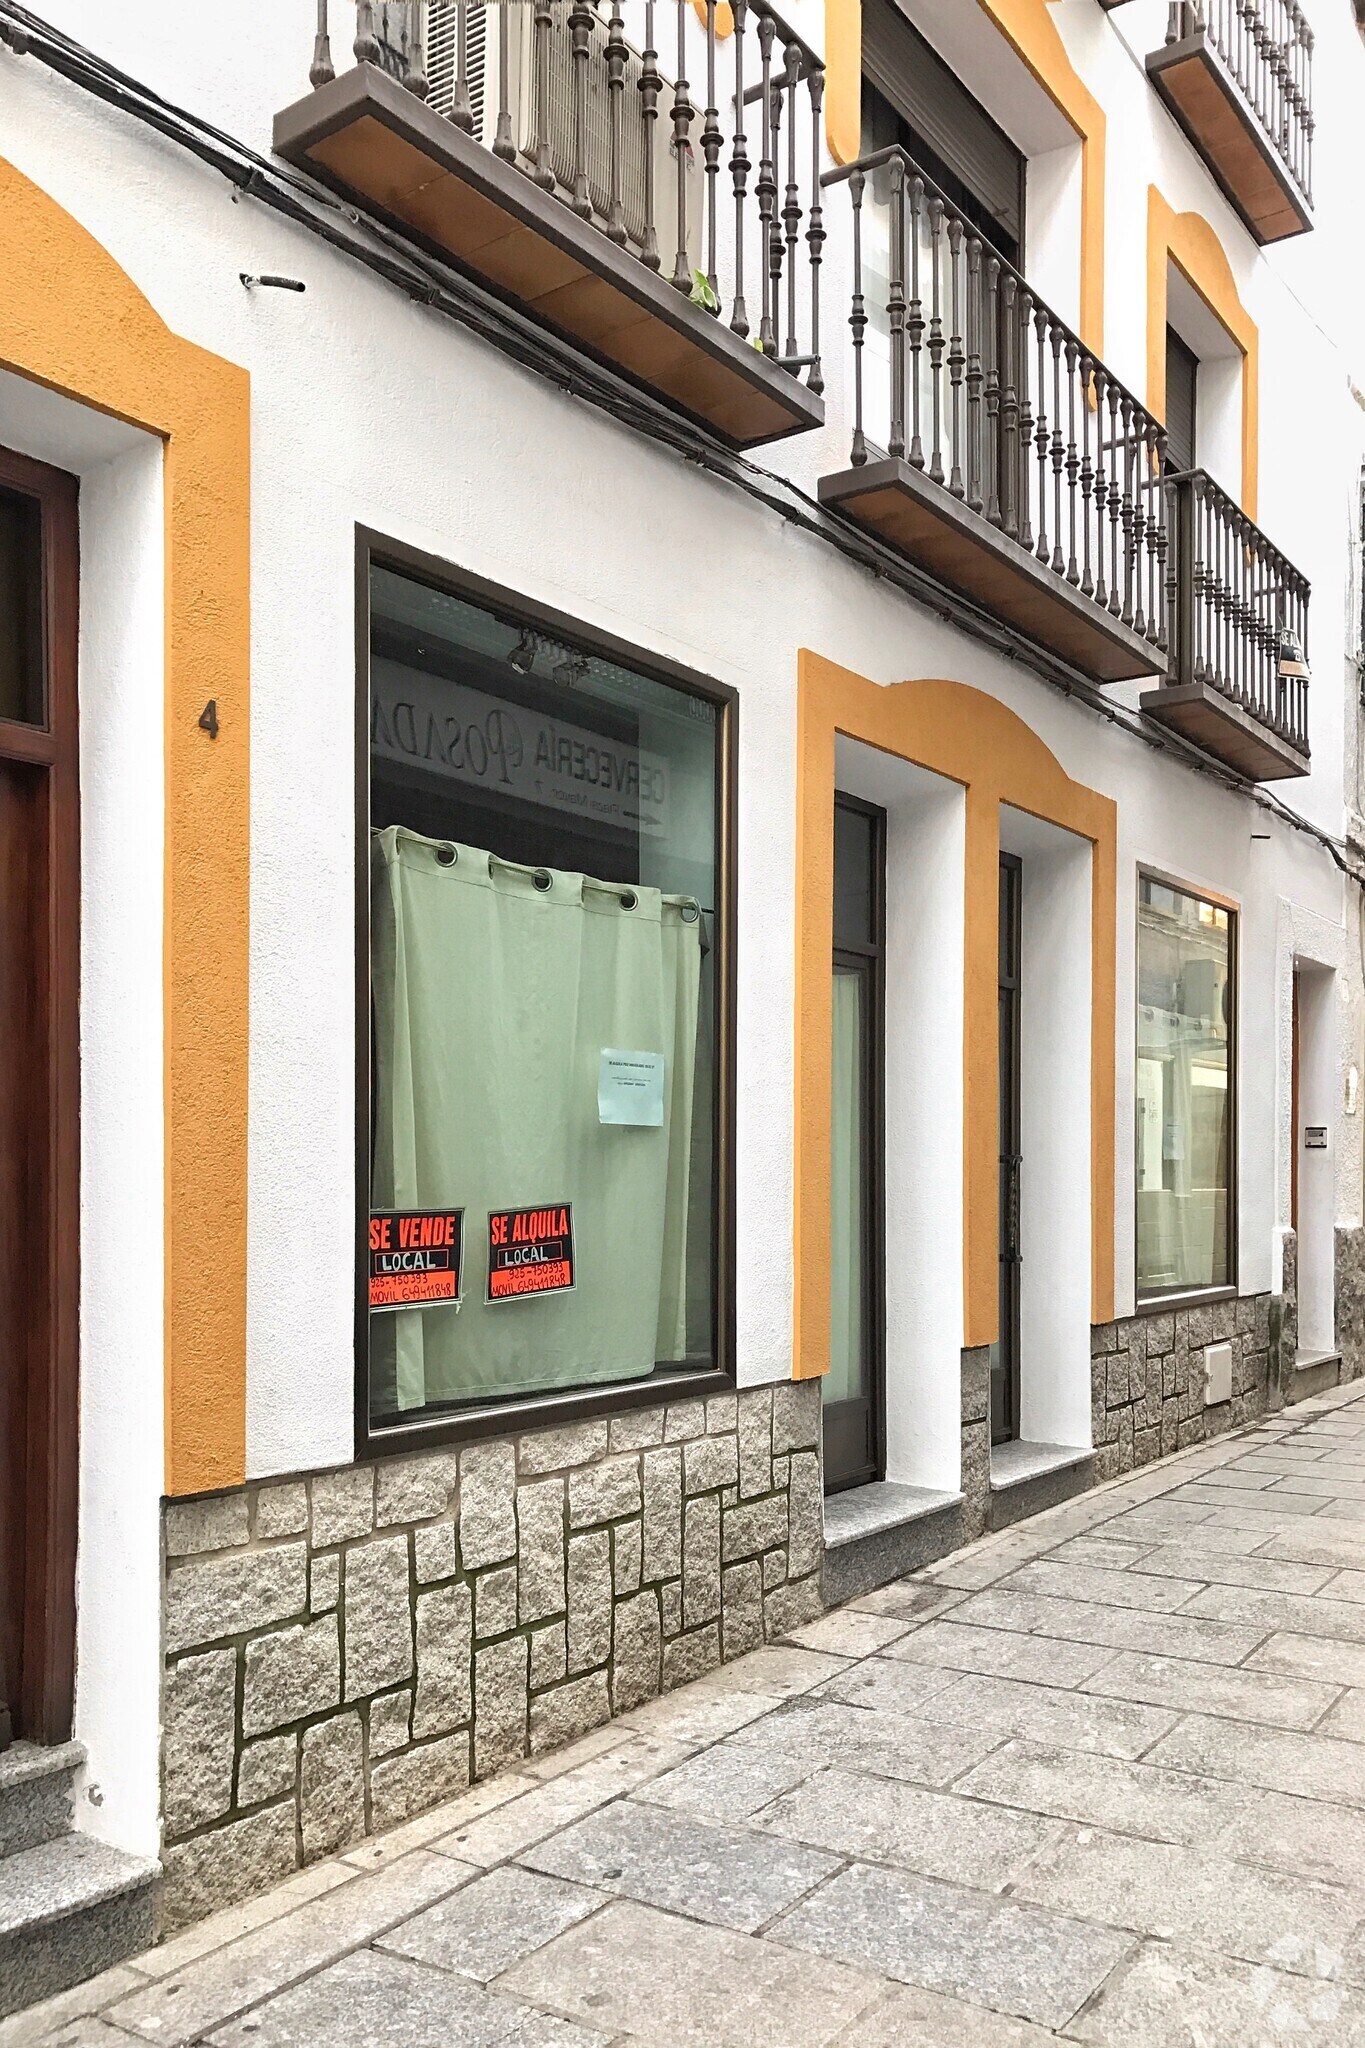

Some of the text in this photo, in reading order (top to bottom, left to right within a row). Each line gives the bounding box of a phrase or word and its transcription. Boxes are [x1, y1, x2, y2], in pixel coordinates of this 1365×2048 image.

[199, 699, 219, 739] 4
[369, 1216, 456, 1250] SE VENDE
[491, 1208, 568, 1245] SE ALQUILA
[382, 1251, 436, 1271] LOCAL
[505, 1246, 549, 1266] LOCAL
